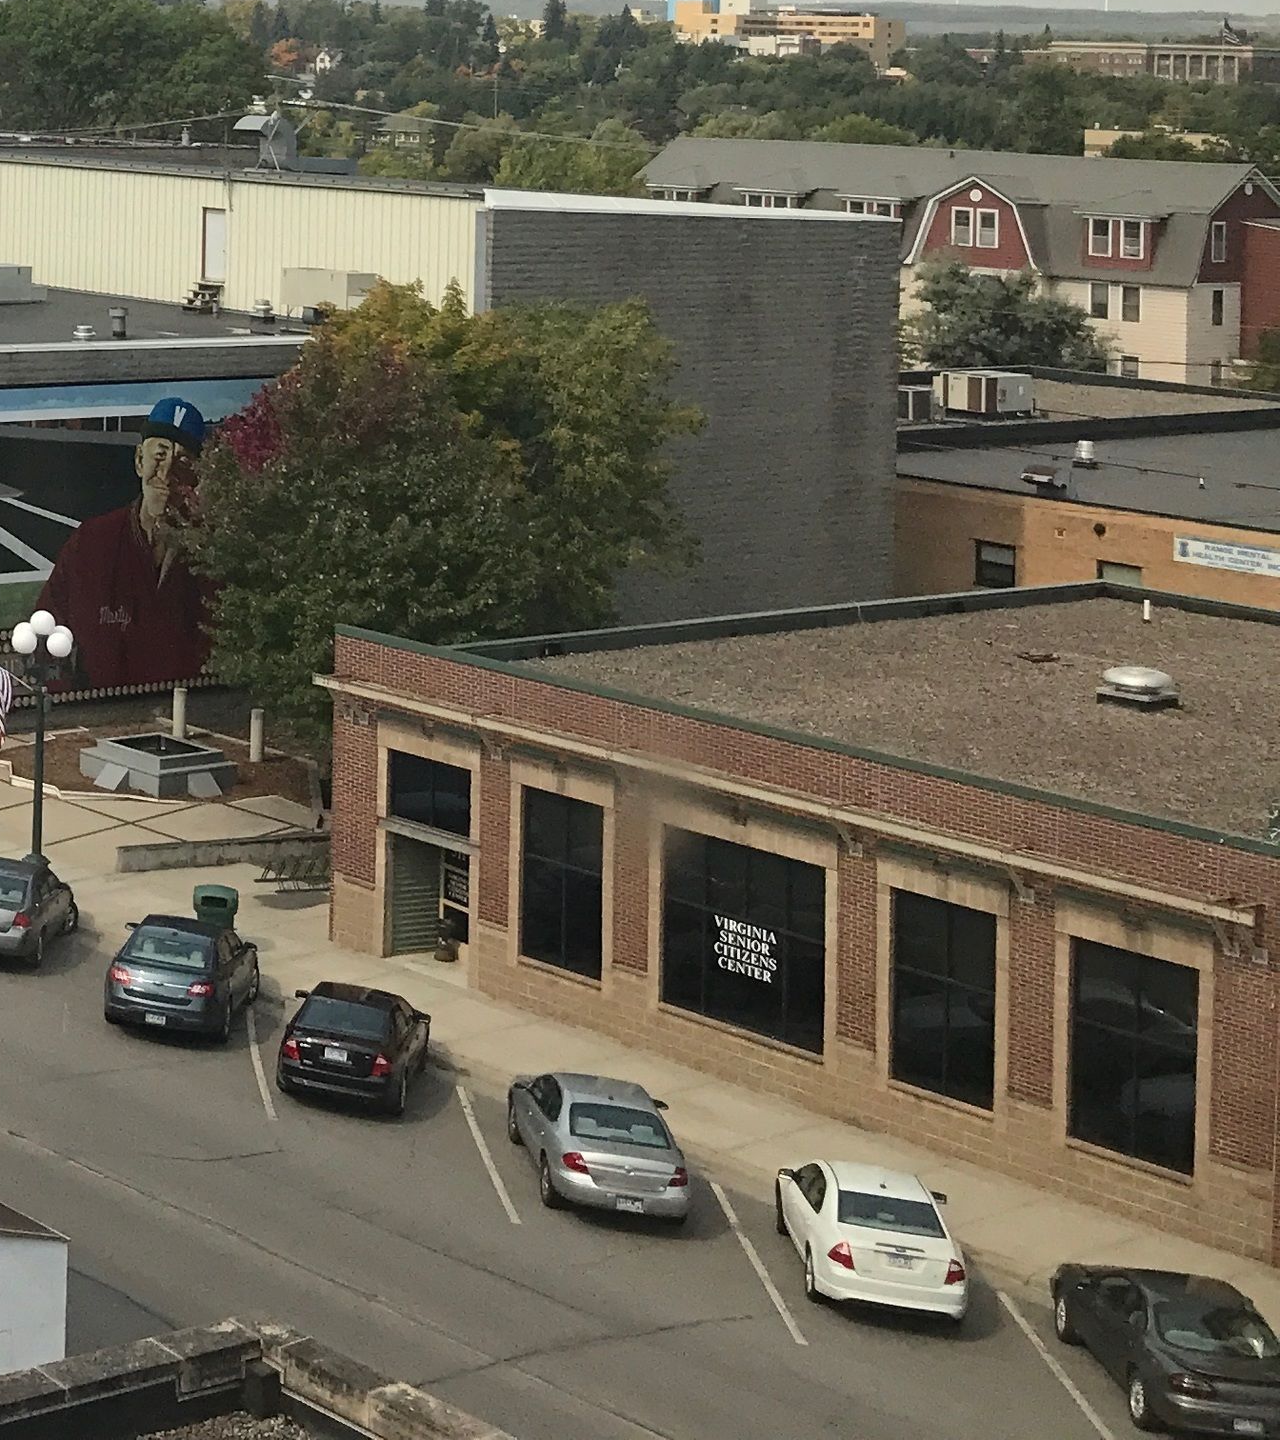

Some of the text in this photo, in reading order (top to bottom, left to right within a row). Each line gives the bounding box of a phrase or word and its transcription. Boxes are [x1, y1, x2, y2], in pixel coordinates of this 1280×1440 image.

[173, 406, 187, 427] V
[1237, 549, 1272, 560] MENTAL
[99, 605, 132, 630] Marty
[714, 914, 777, 944] VIRGINIA
[719, 929, 771, 956] SENIOR
[713, 941, 777, 971] CITIZENS
[718, 956, 772, 983] CENTER
